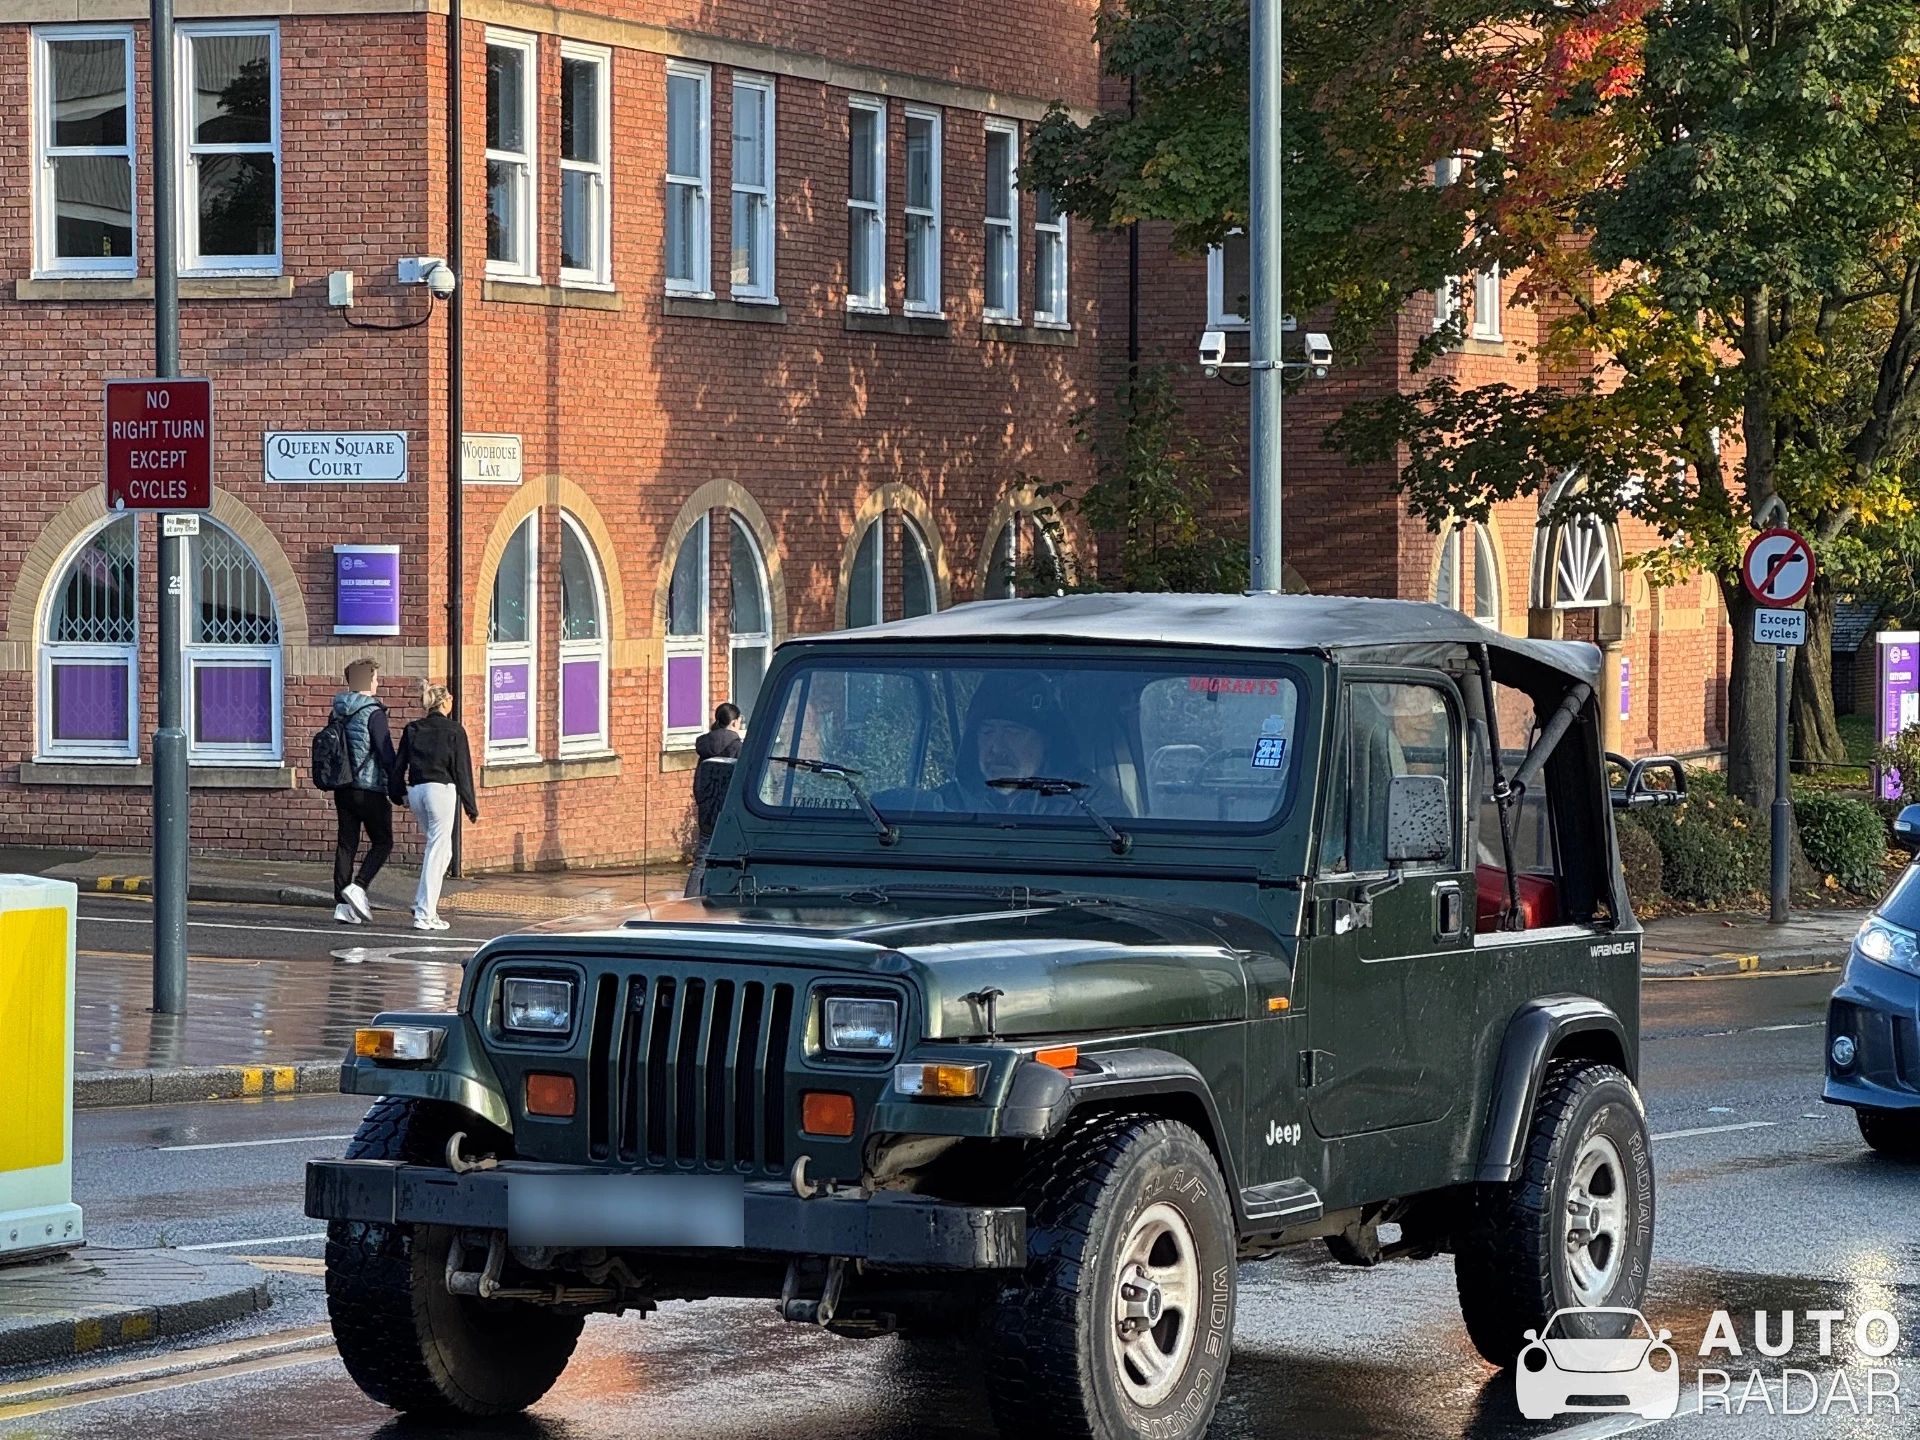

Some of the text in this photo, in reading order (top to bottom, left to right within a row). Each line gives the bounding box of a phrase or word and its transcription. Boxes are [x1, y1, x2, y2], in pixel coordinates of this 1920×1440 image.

[146, 390, 170, 409] NO
[112, 420, 205, 439] RIGHT TURN
[277, 437, 395, 459] QUEEN SQUARE
[462, 441, 517, 460] WOODHOUSE
[130, 450, 187, 469] EXCEPT
[308, 458, 363, 476] COURT
[478, 460, 501, 477] LANE
[129, 480, 187, 499] CYCLES
[1760, 613, 1801, 627] Except
[1760, 628, 1799, 640] cycles
[1590, 941, 1635, 958] WRANGLER
[1265, 1119, 1301, 1146] Jeep
[1169, 1169, 1208, 1203] A/T
[1628, 1130, 1651, 1248] RADIAL
[1205, 1265, 1228, 1358] WIDE
